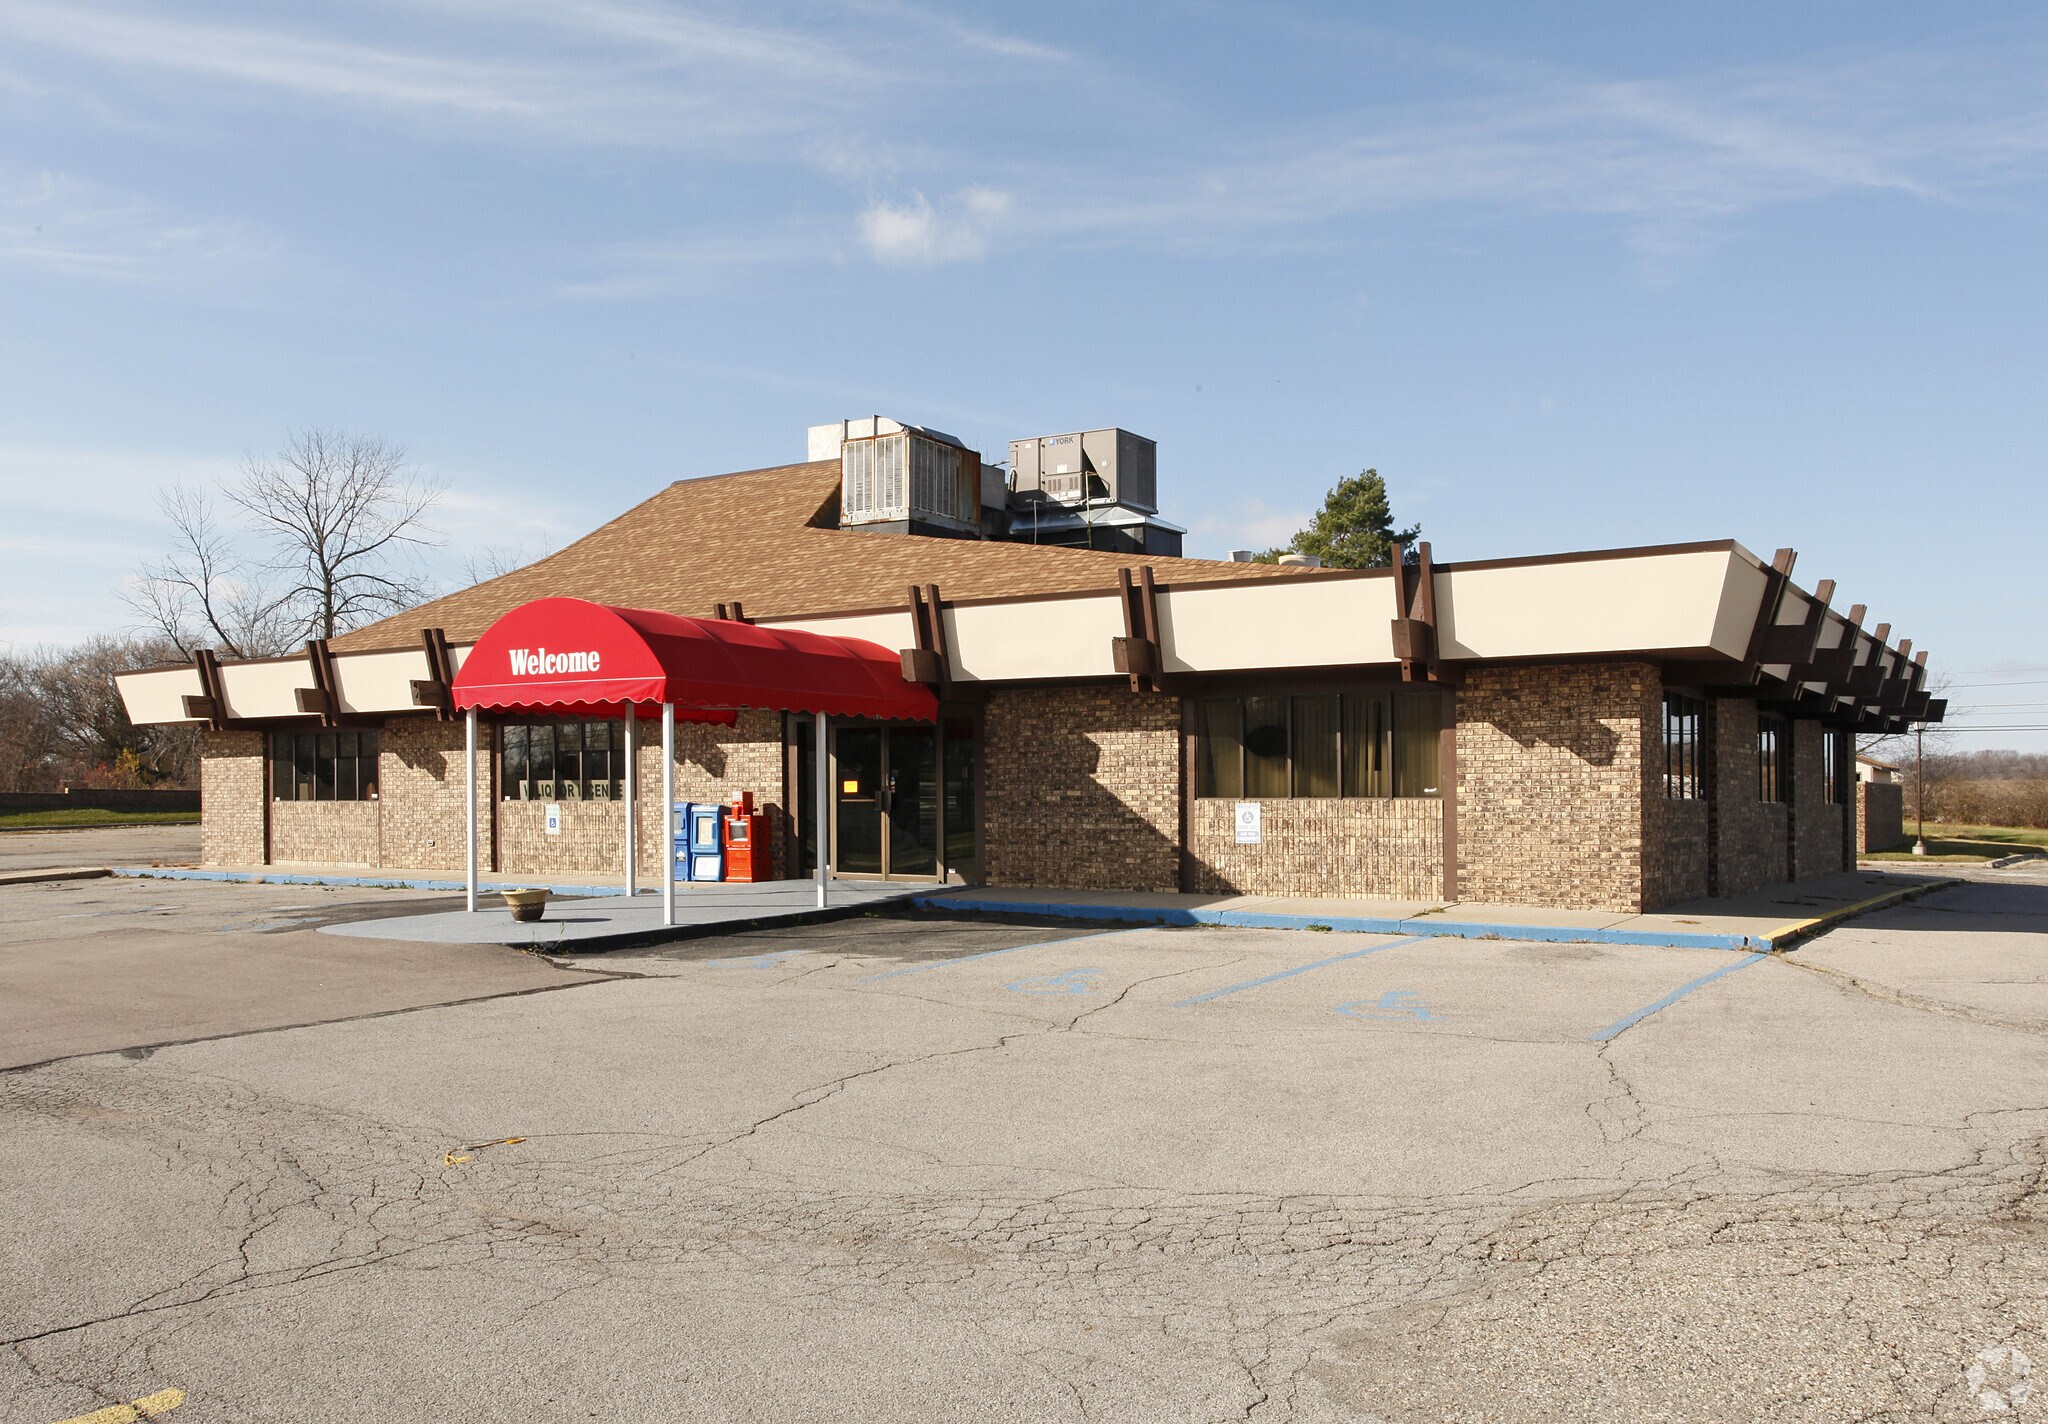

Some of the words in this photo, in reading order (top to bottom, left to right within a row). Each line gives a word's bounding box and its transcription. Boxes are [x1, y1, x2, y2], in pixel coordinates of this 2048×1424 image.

[1055, 436, 1074, 445] YORK
[509, 647, 600, 675] Welcome
[536, 784, 575, 798] LIQOR
[577, 784, 623, 798] CENE
